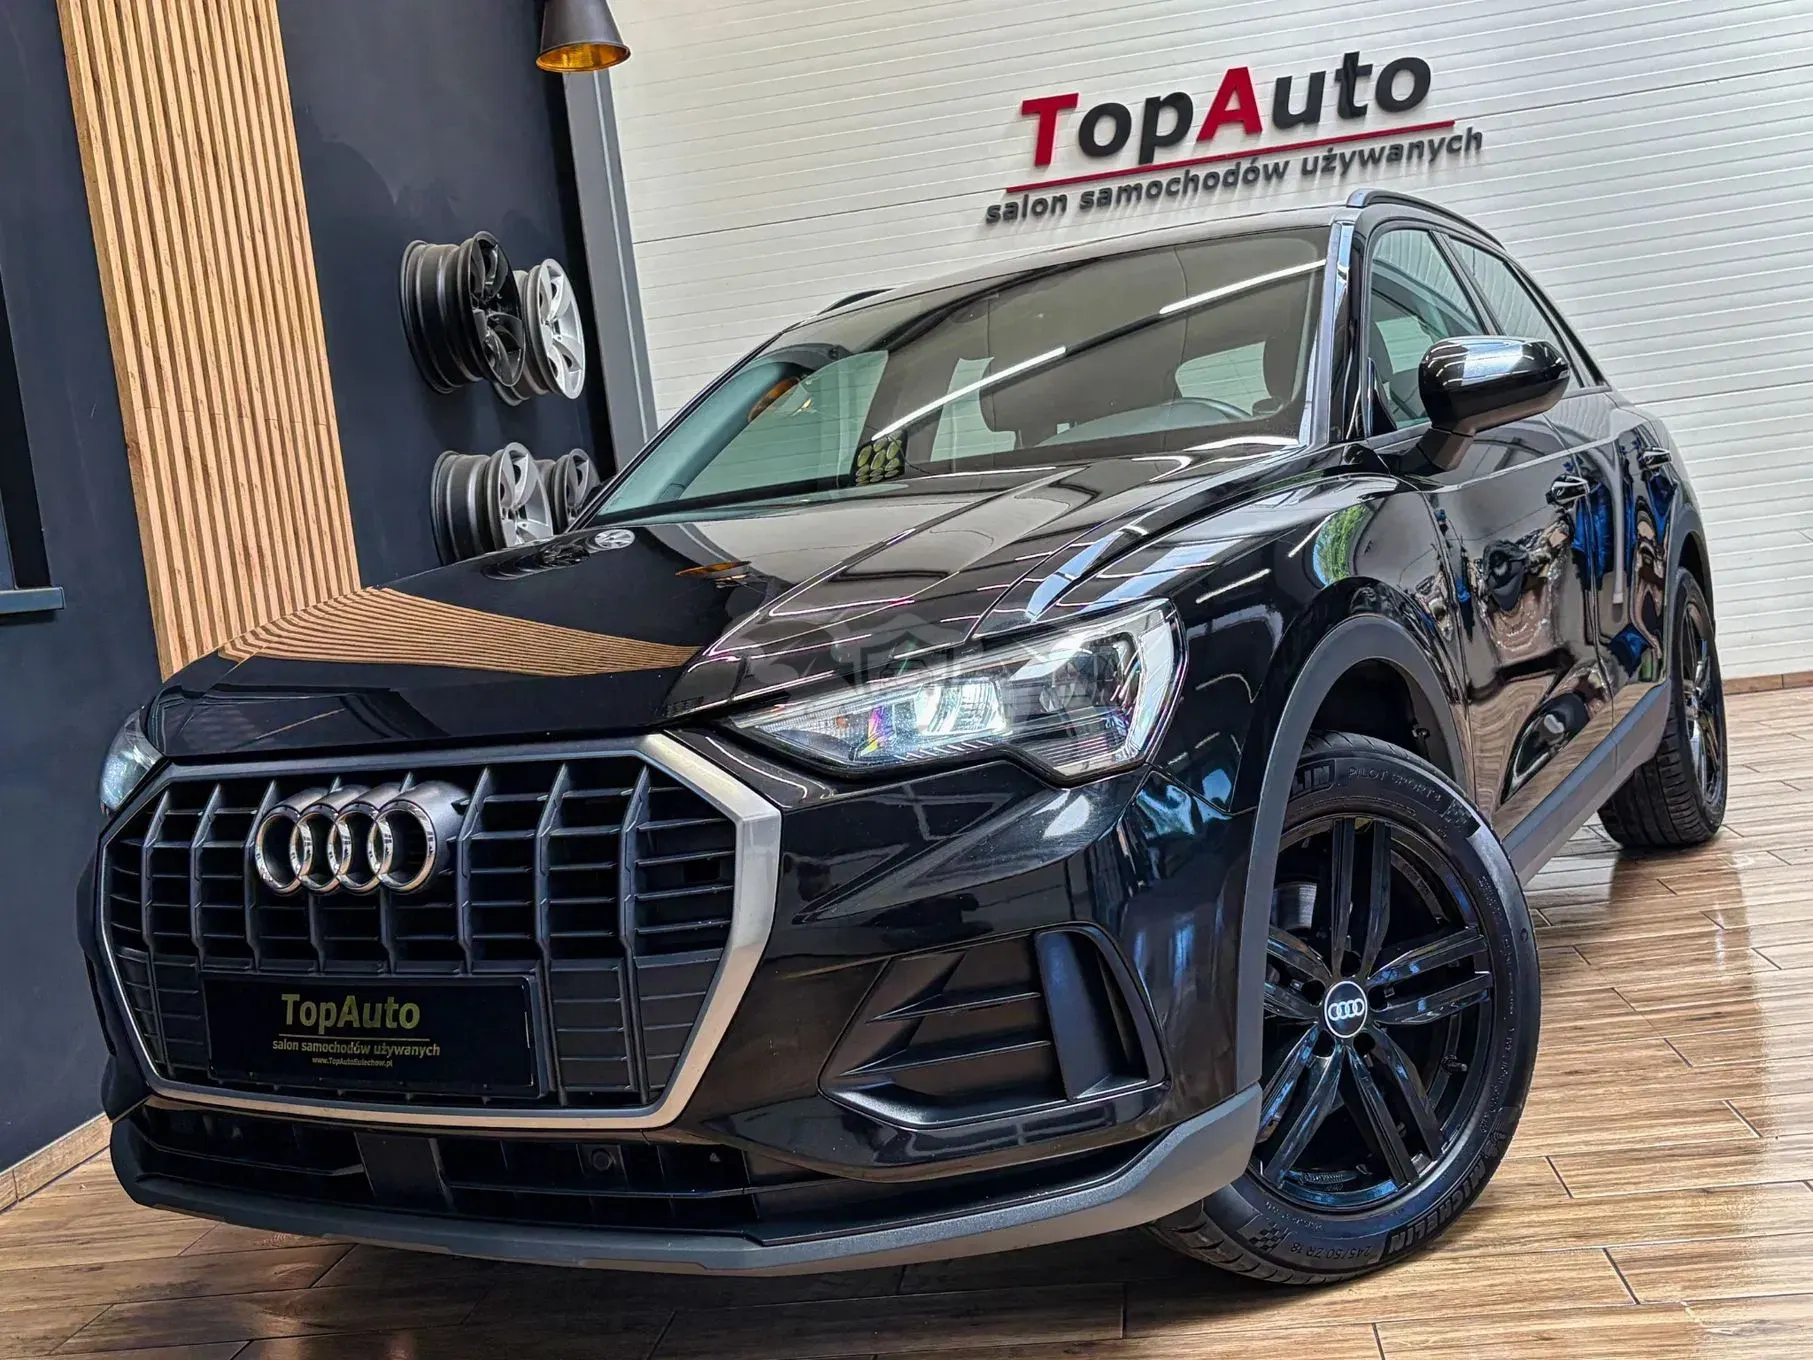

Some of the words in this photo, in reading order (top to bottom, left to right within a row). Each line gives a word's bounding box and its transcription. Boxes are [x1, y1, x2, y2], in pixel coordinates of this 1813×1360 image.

[1020, 50, 1432, 167] TopAuto
[985, 194, 1068, 224] salon
[1080, 158, 1290, 214] samochodów
[1300, 127, 1483, 178] używanych
[281, 993, 421, 1035] TopAuto
[272, 1038, 299, 1051] salon
[301, 1040, 371, 1055] samochodów
[373, 1042, 441, 1059] używanych
[1387, 1157, 1487, 1256] MICHELIN
[1290, 1242, 1304, 1255] 18
[1305, 1244, 1323, 1259] ZR
[1326, 1244, 1373, 1261] 245/50
